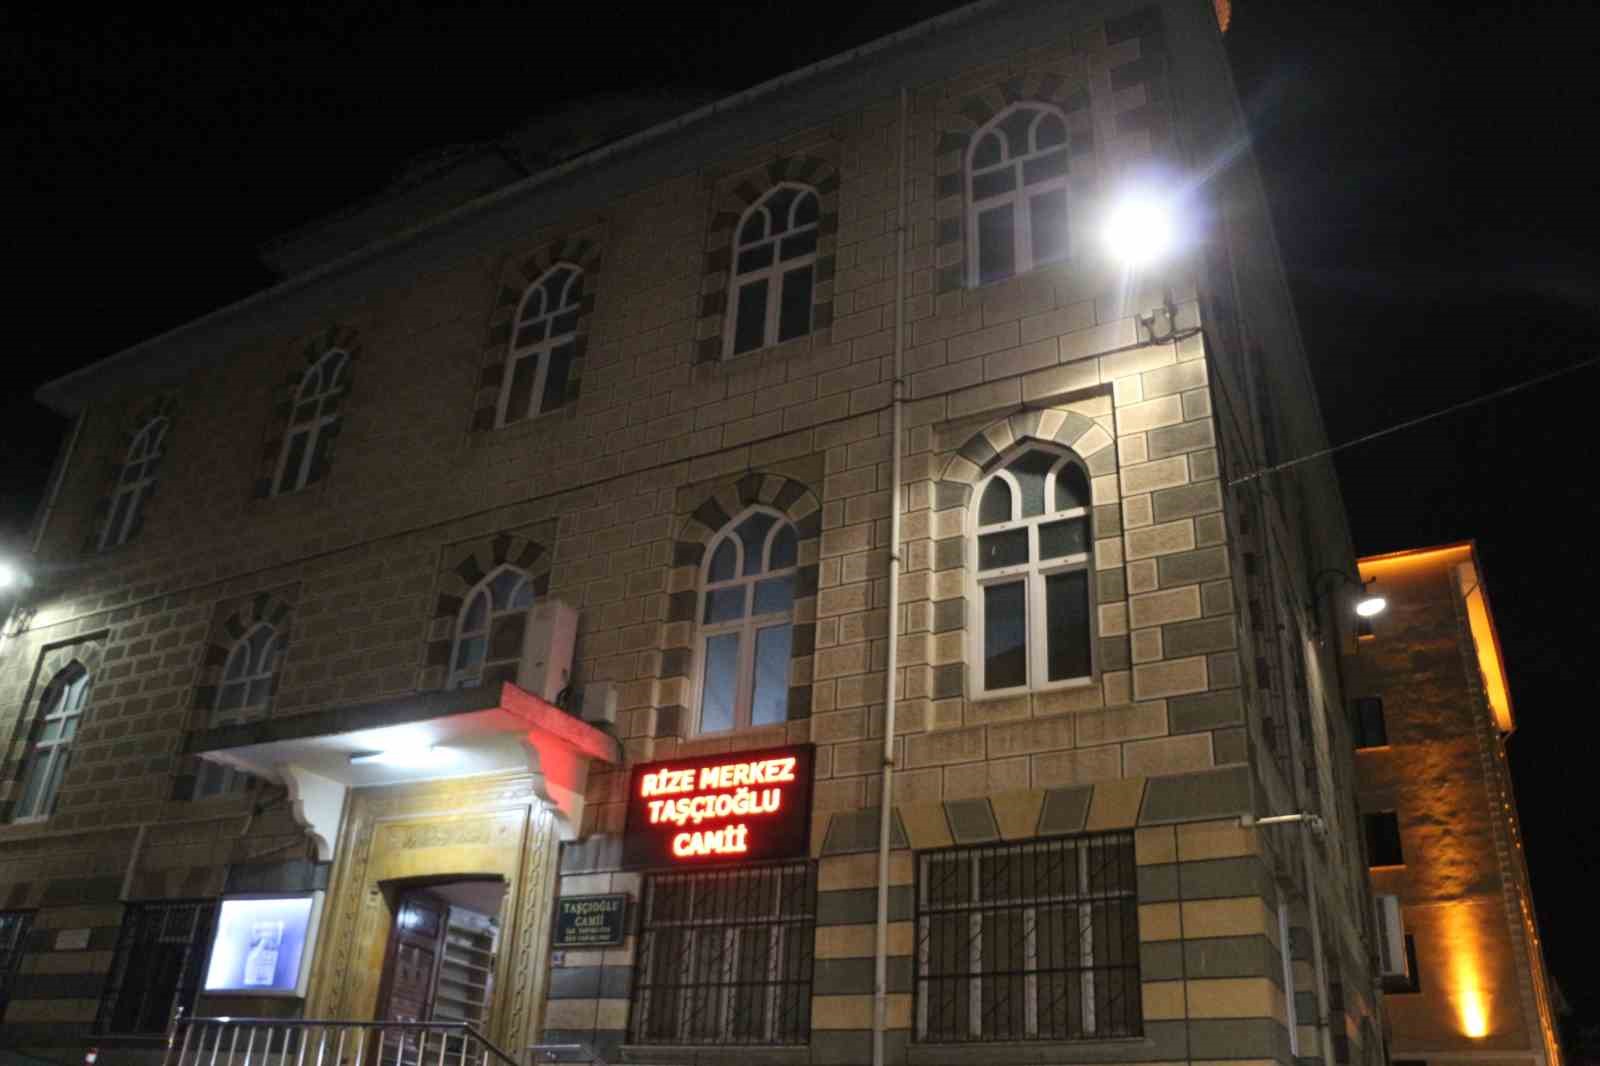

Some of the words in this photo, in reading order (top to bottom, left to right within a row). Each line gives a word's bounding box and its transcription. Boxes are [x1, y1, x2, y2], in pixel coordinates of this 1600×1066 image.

[641, 768, 696, 797] RİZE
[699, 757, 796, 790] MERKEZ
[648, 786, 781, 826] TAŞÇIOĞLU
[673, 824, 748, 857] CAMİİ
